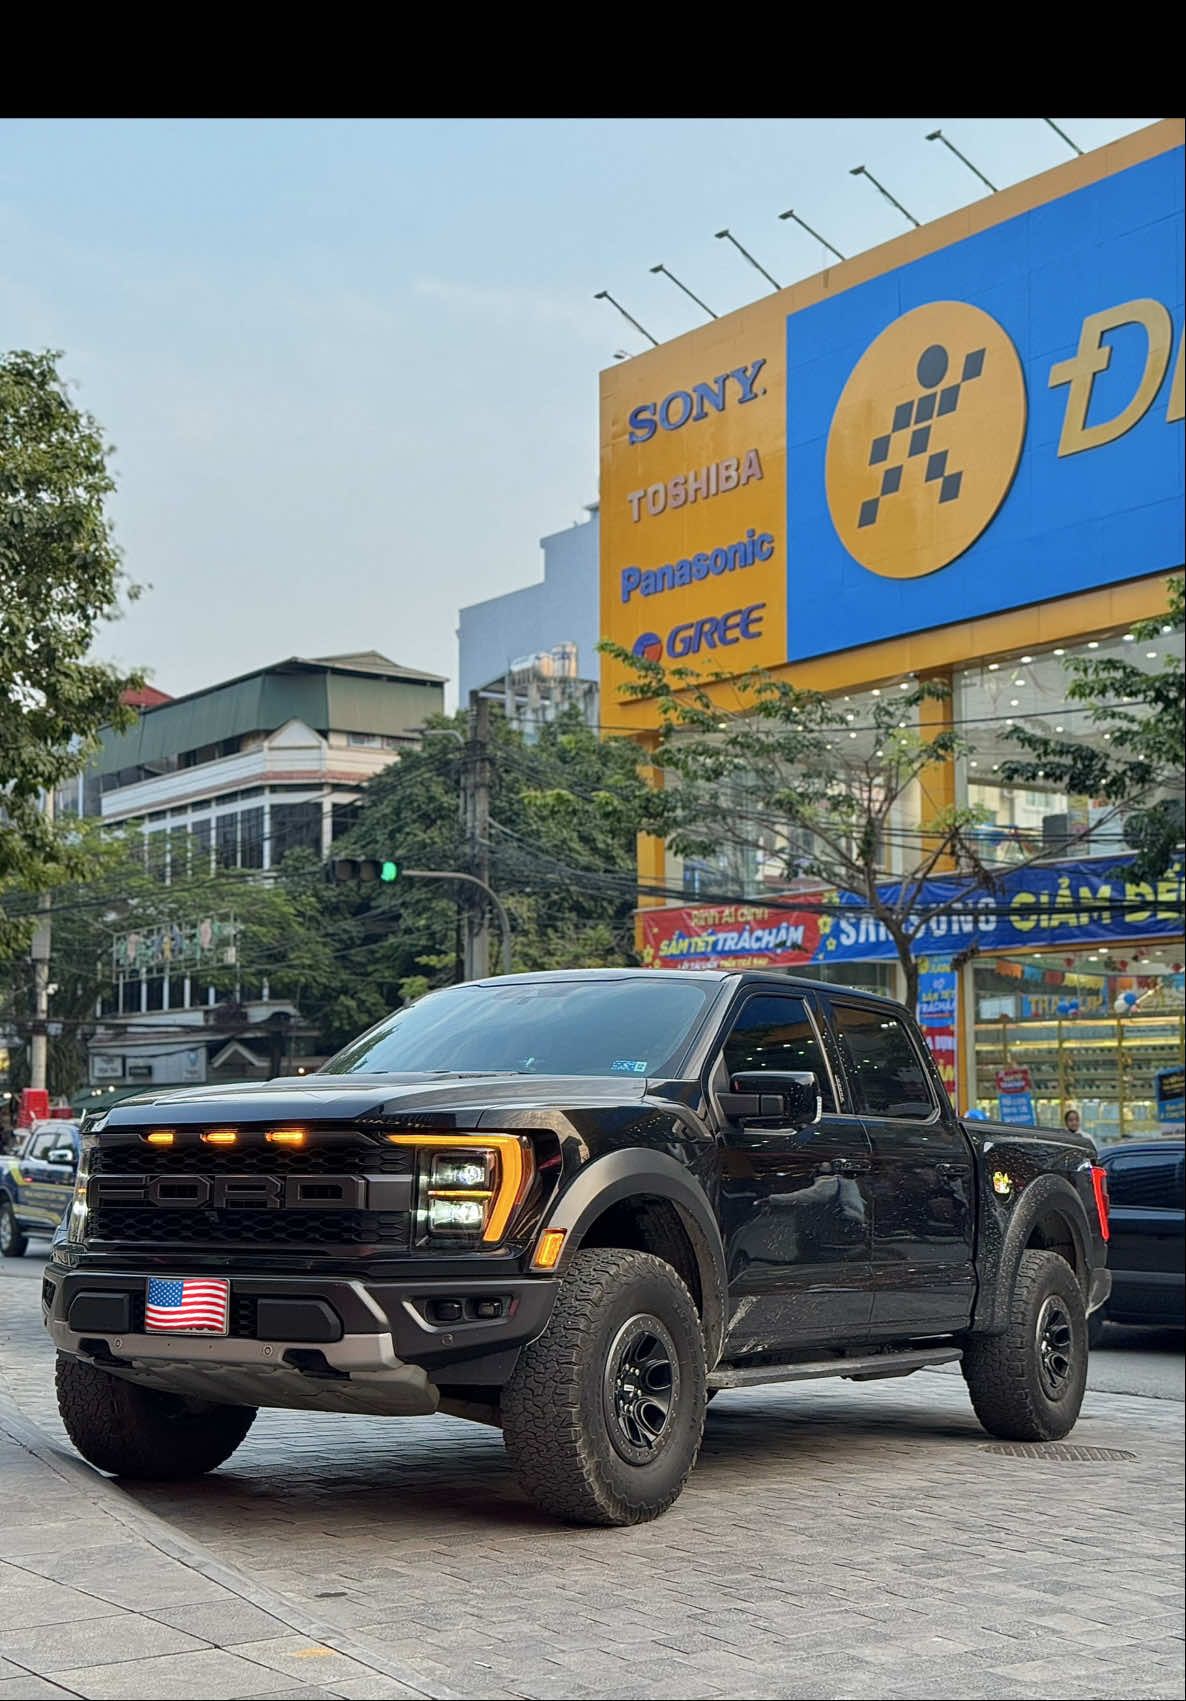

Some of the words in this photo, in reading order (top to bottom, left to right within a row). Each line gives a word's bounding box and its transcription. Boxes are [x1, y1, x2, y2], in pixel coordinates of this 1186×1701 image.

[627, 448, 764, 524] TOSHIBA
[621, 528, 775, 604] Panasonic
[666, 602, 767, 661] GREE
[1009, 876, 1112, 932] GIẢM
[1121, 862, 1185, 924] ĐẾ
[87, 1174, 364, 1210] FORD
